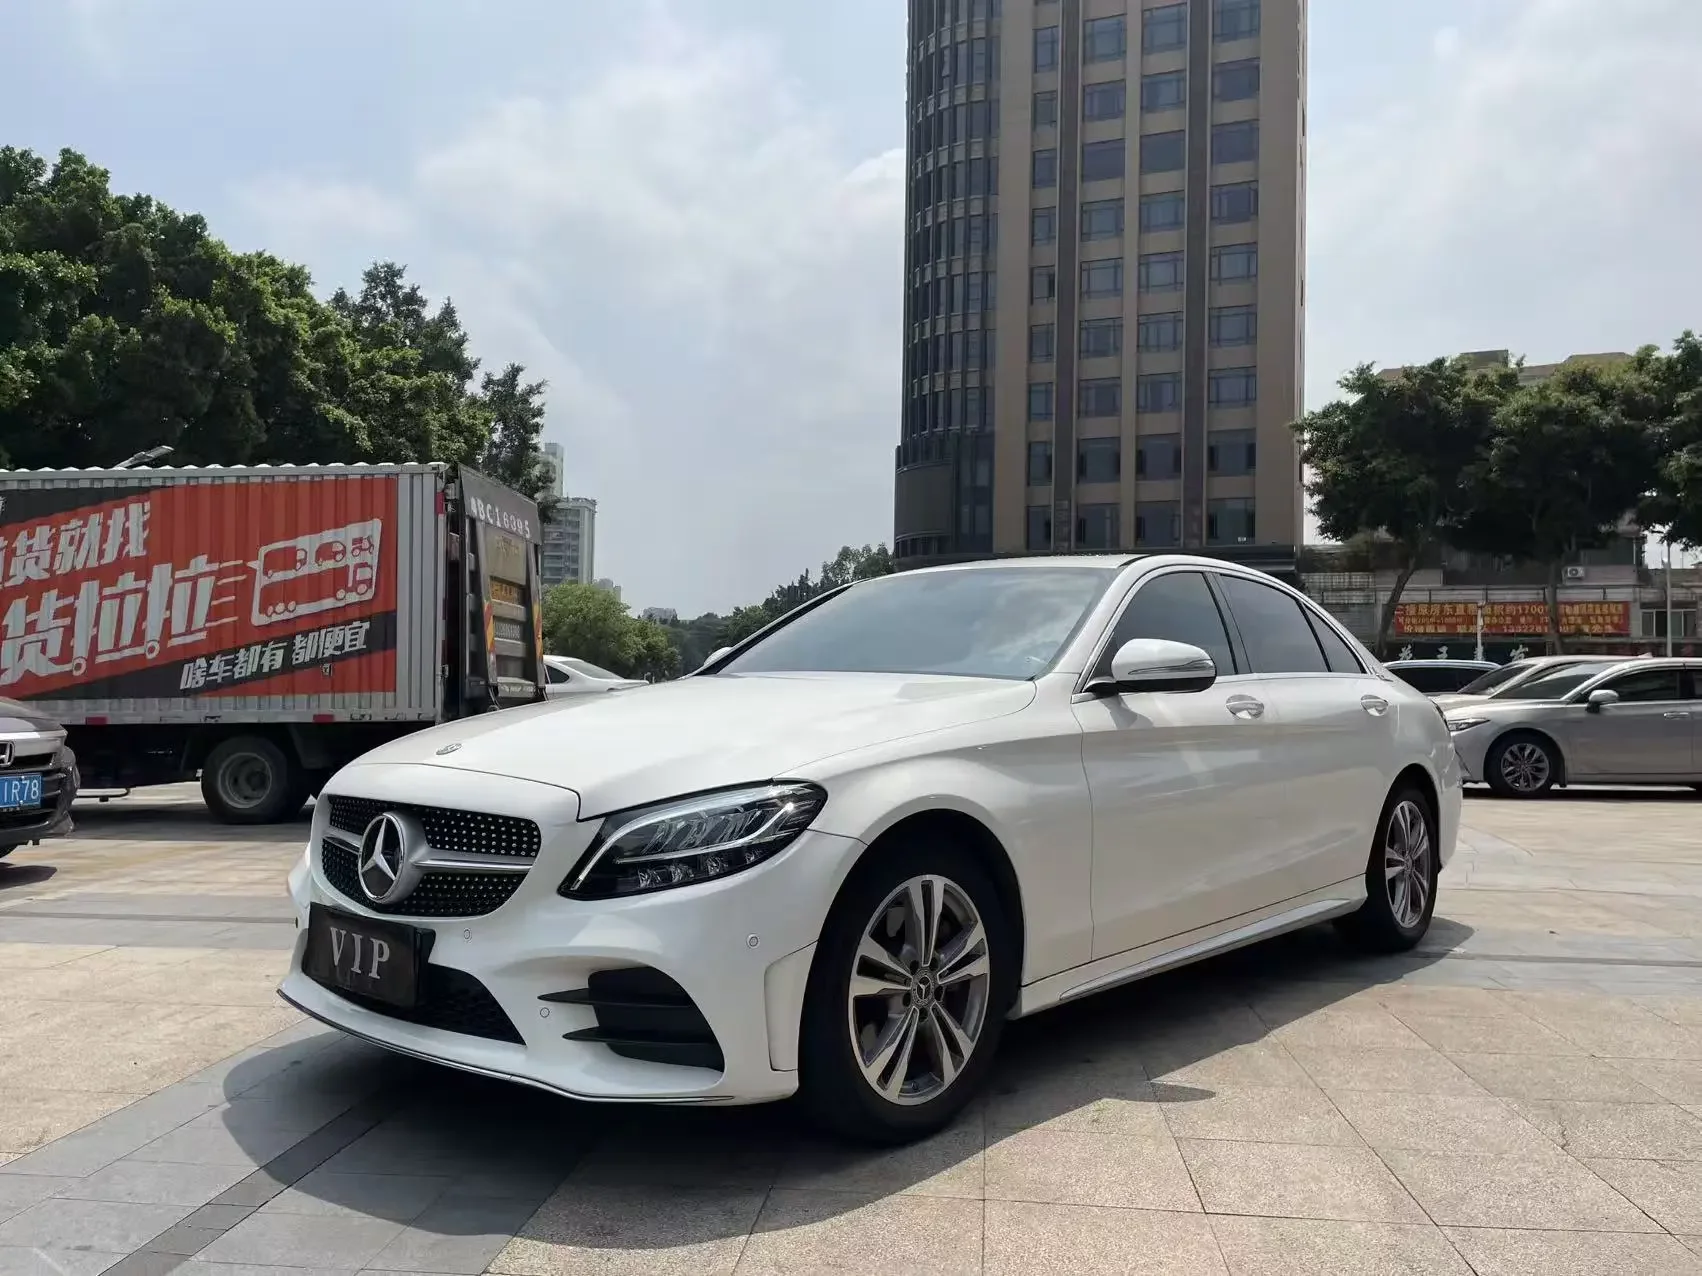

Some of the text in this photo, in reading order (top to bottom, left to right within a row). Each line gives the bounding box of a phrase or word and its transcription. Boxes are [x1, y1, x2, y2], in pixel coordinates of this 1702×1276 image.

[0, 554, 220, 686] 货拉拉
[180, 621, 370, 690] 啥车都有 都便宜
[330, 927, 390, 979] VIP
